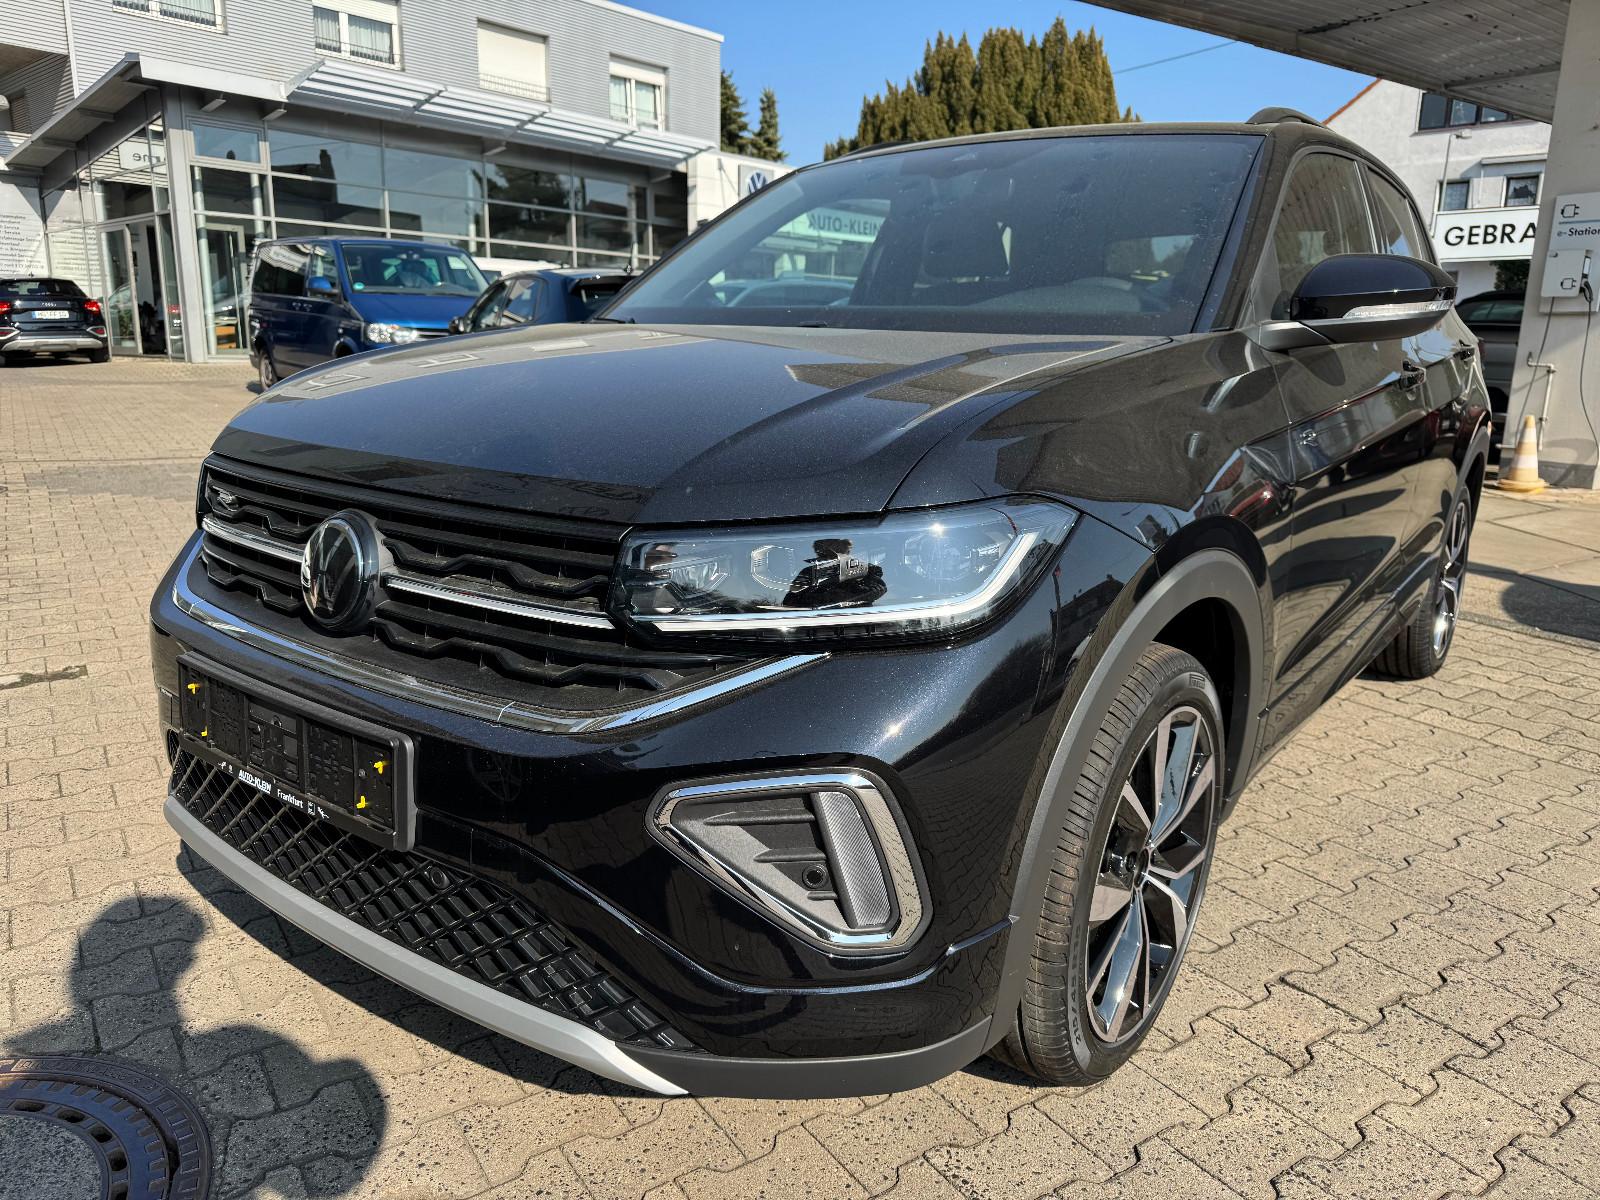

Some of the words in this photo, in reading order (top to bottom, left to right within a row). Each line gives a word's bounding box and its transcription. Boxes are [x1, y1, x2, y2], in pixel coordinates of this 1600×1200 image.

[1444, 222, 1537, 247] GEBRA
[238, 769, 271, 794] AUTO-KLEIN
[277, 788, 304, 809] Frankfurt
